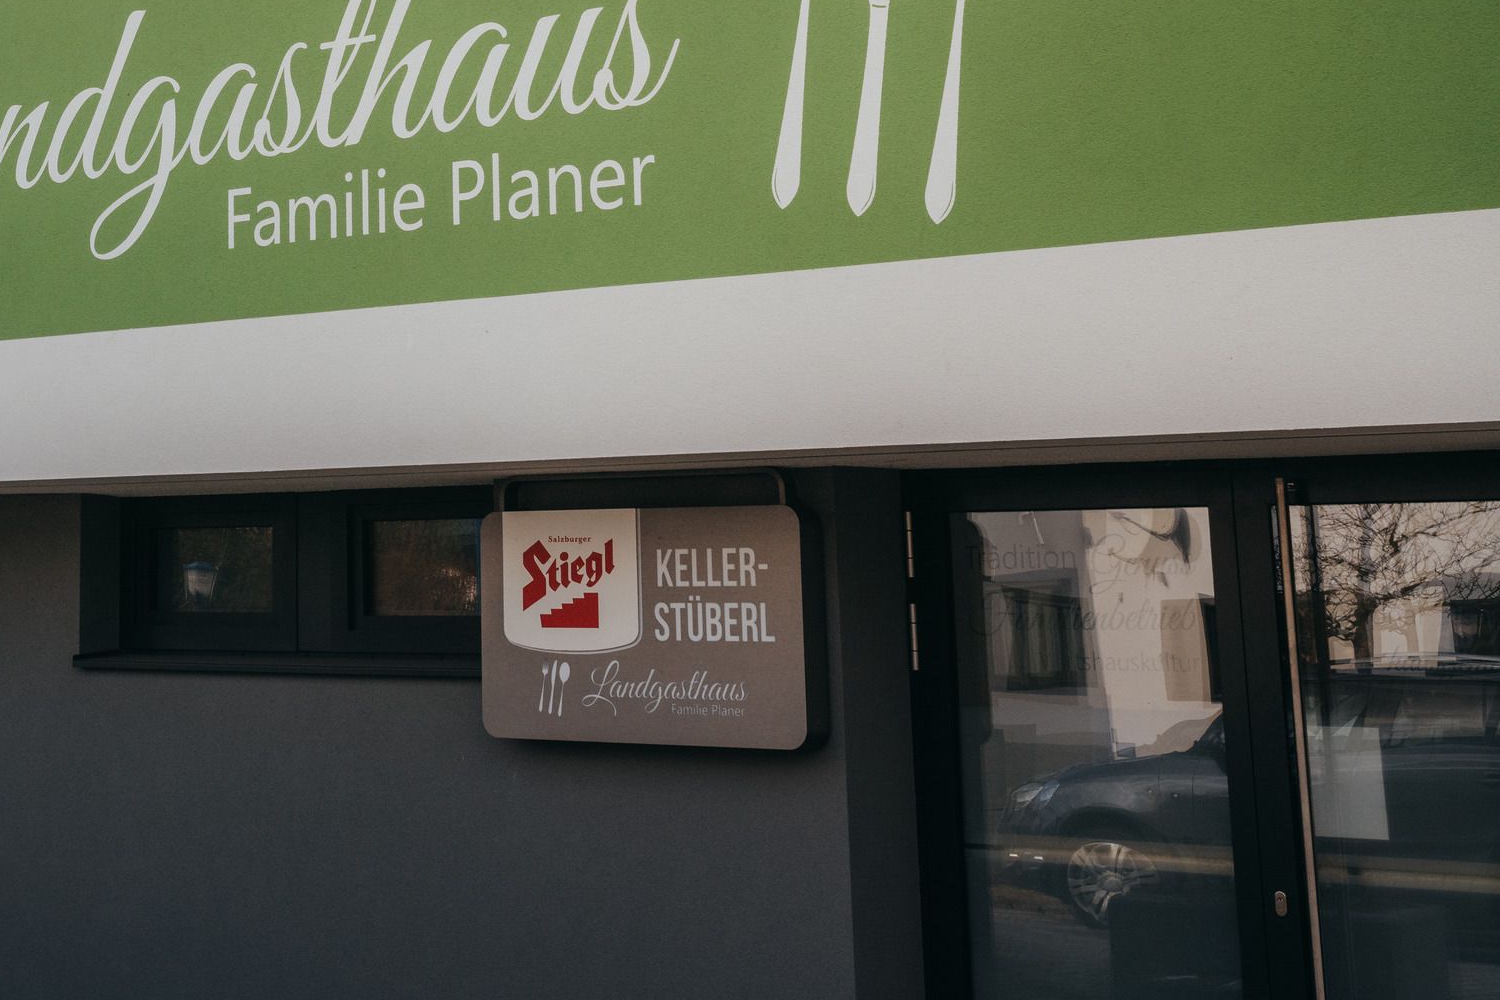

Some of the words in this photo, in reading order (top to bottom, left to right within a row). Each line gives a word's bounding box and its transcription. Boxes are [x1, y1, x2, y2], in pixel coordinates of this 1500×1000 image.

[227, 167, 426, 250] Familie
[450, 153, 656, 226] Planer
[547, 535, 592, 545] Salzburger
[964, 543, 1076, 570] Tradition
[522, 537, 616, 612] Stiegl
[655, 546, 769, 589] KELLER-
[653, 595, 776, 643] STÜBERL
[581, 659, 749, 717] Landgasthaus
[671, 703, 708, 717] Familie
[711, 703, 746, 718] Planer
